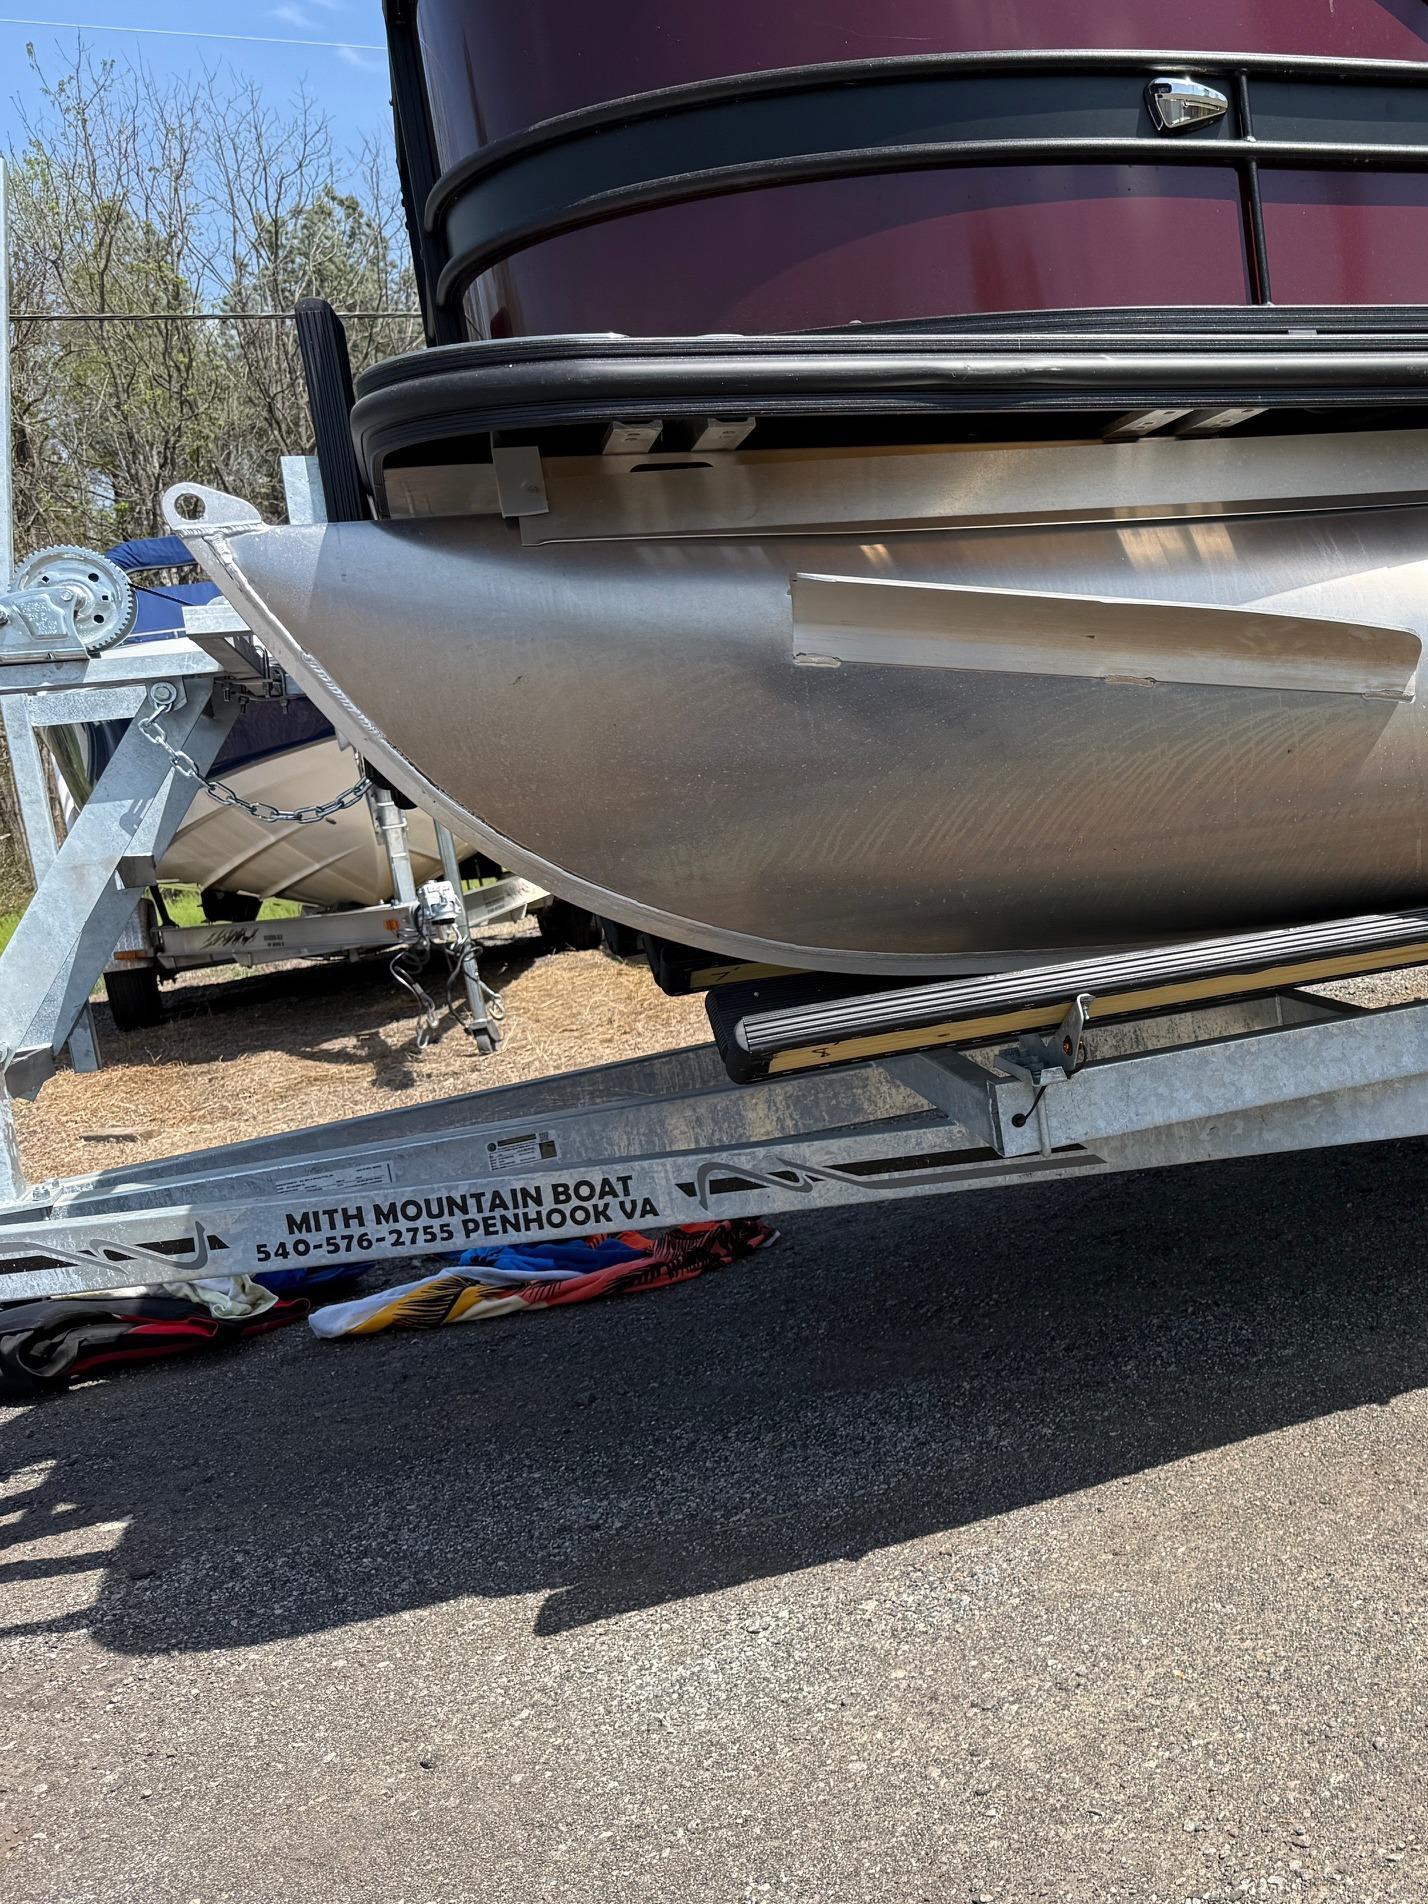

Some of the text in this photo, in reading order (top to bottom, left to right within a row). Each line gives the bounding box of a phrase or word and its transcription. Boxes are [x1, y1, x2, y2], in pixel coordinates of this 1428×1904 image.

[256, 1196, 660, 1263] 540-576-2755 PENHOOK VA
[285, 1174, 633, 1236] MITH MOUNTAIN BOAT
